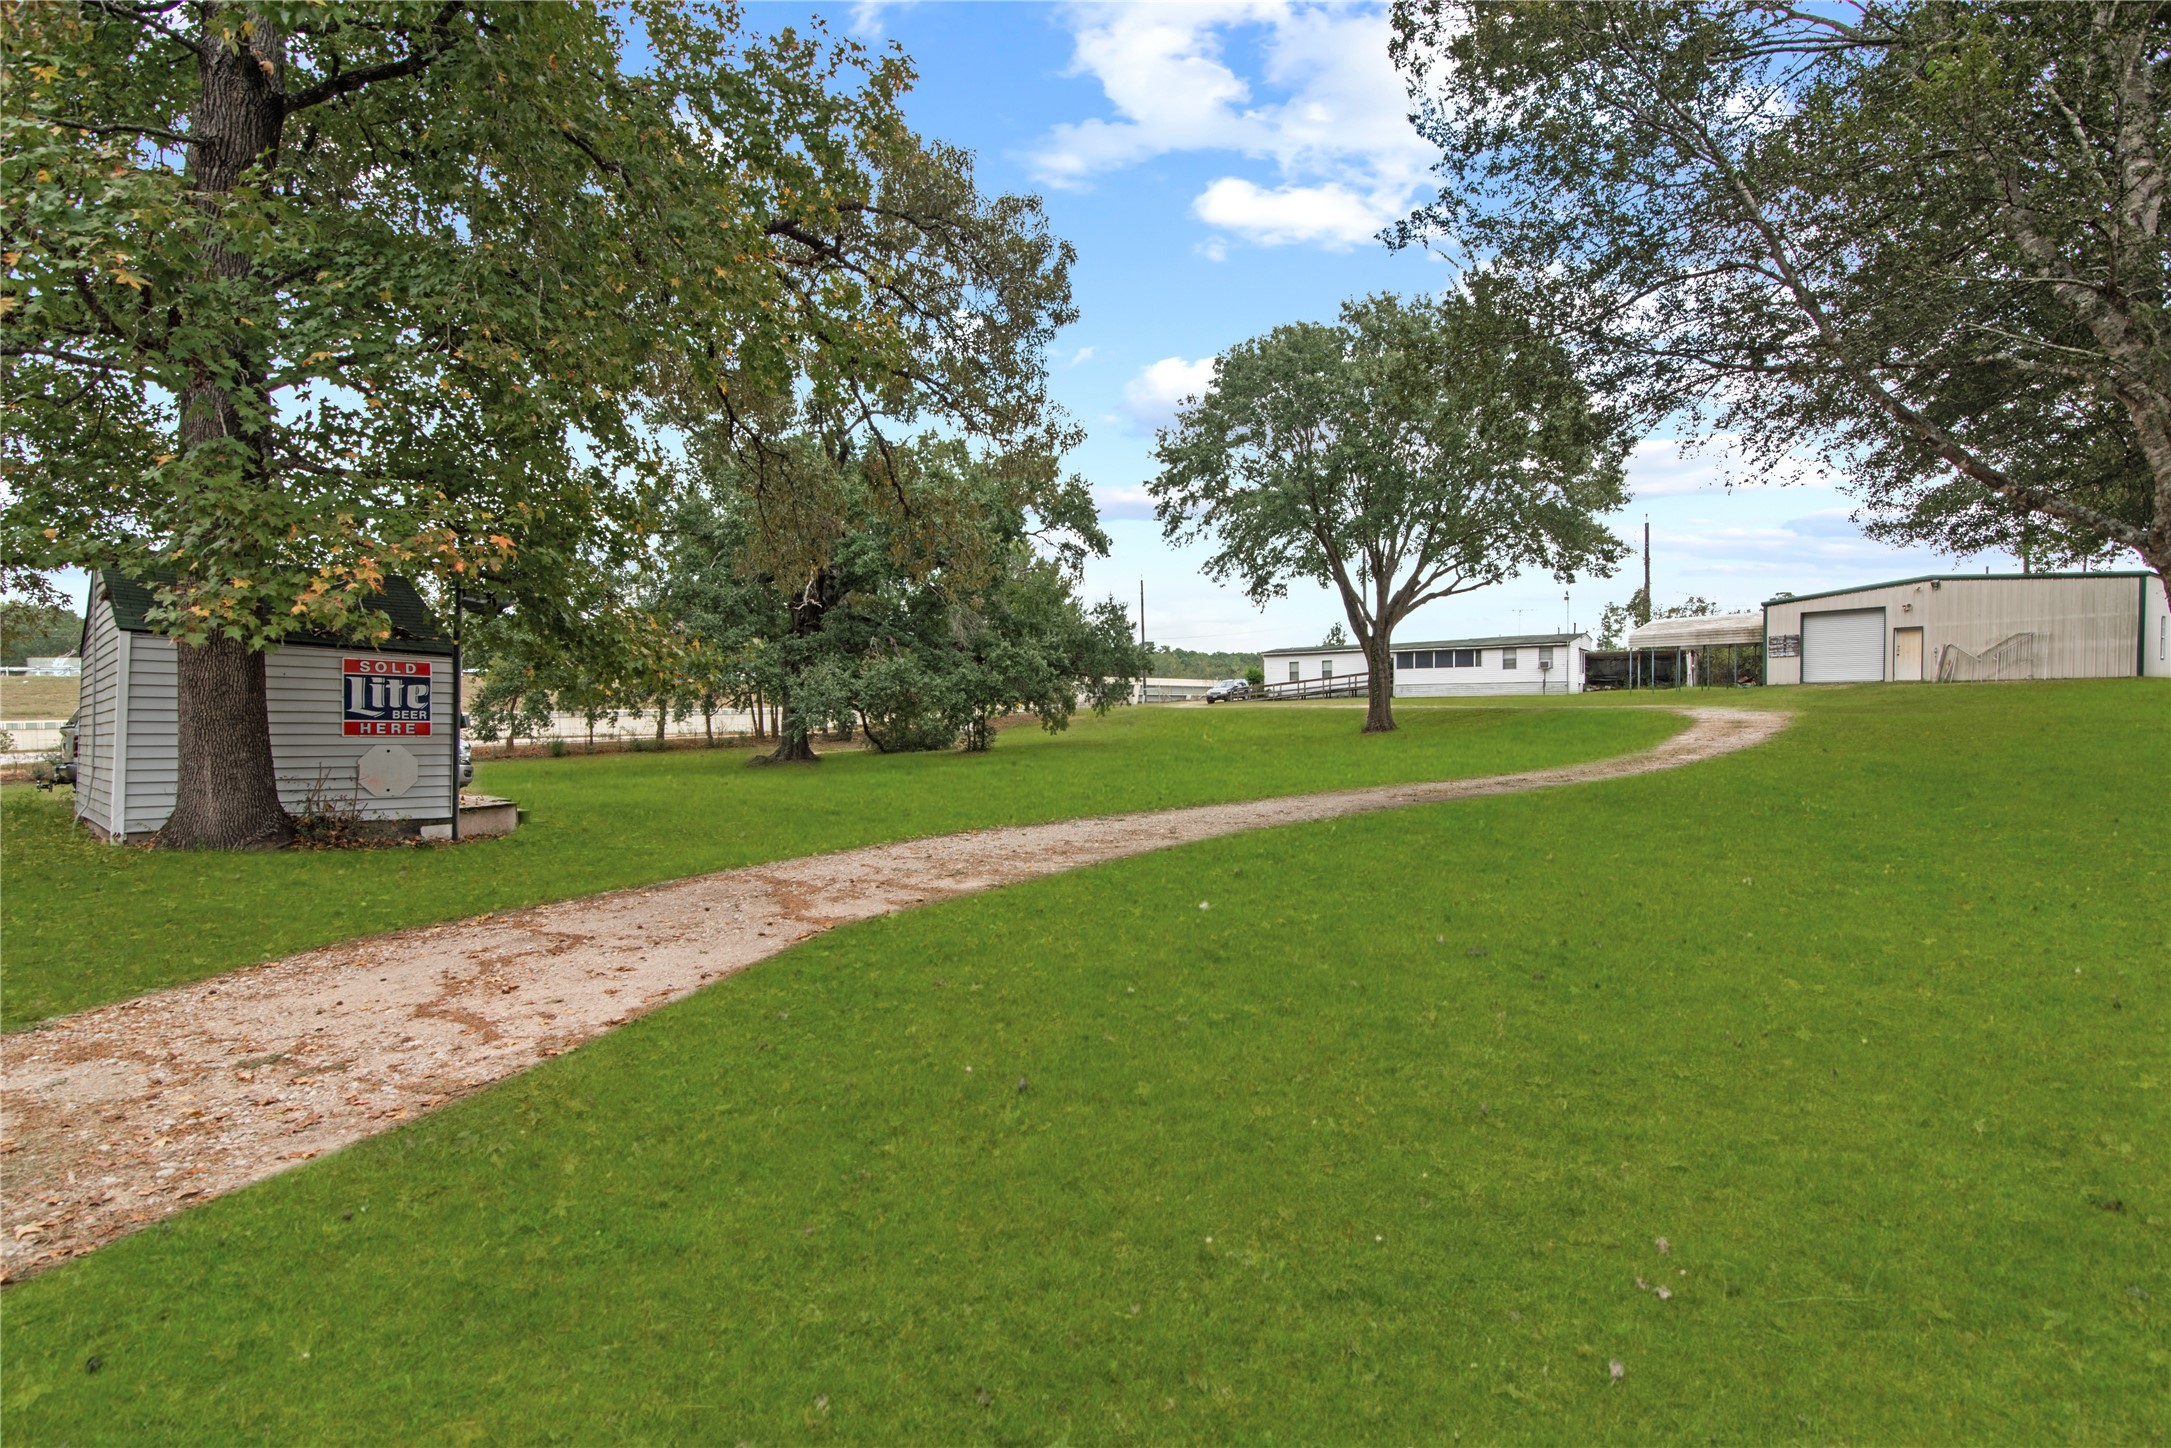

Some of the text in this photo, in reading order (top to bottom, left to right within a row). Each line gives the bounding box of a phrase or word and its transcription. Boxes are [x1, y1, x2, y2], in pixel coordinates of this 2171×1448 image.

[359, 661, 417, 674] SOLD
[345, 676, 430, 718] Lite
[392, 710, 427, 719] BEER
[360, 723, 416, 734] HERE
